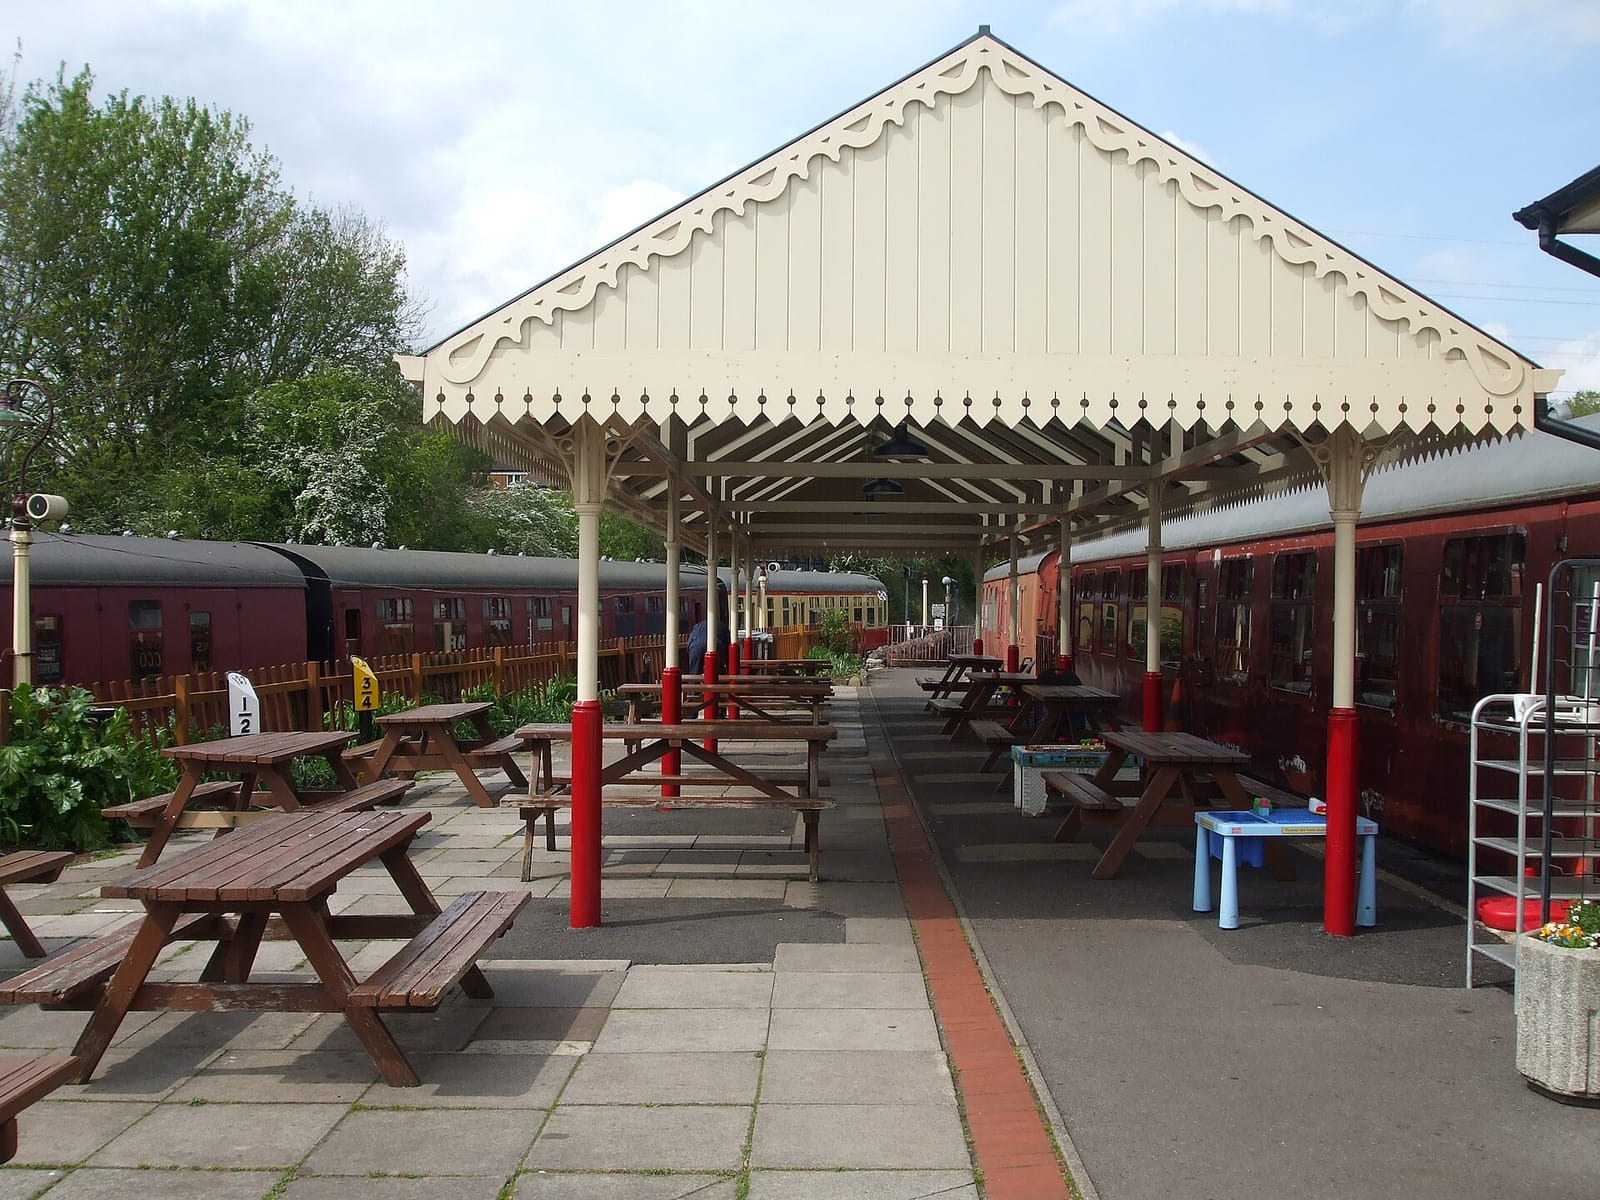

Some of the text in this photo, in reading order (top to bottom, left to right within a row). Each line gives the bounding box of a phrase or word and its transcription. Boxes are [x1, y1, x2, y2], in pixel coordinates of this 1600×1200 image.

[362, 677, 371, 689] 3
[362, 696, 372, 709] 4
[240, 718, 251, 734] 2
